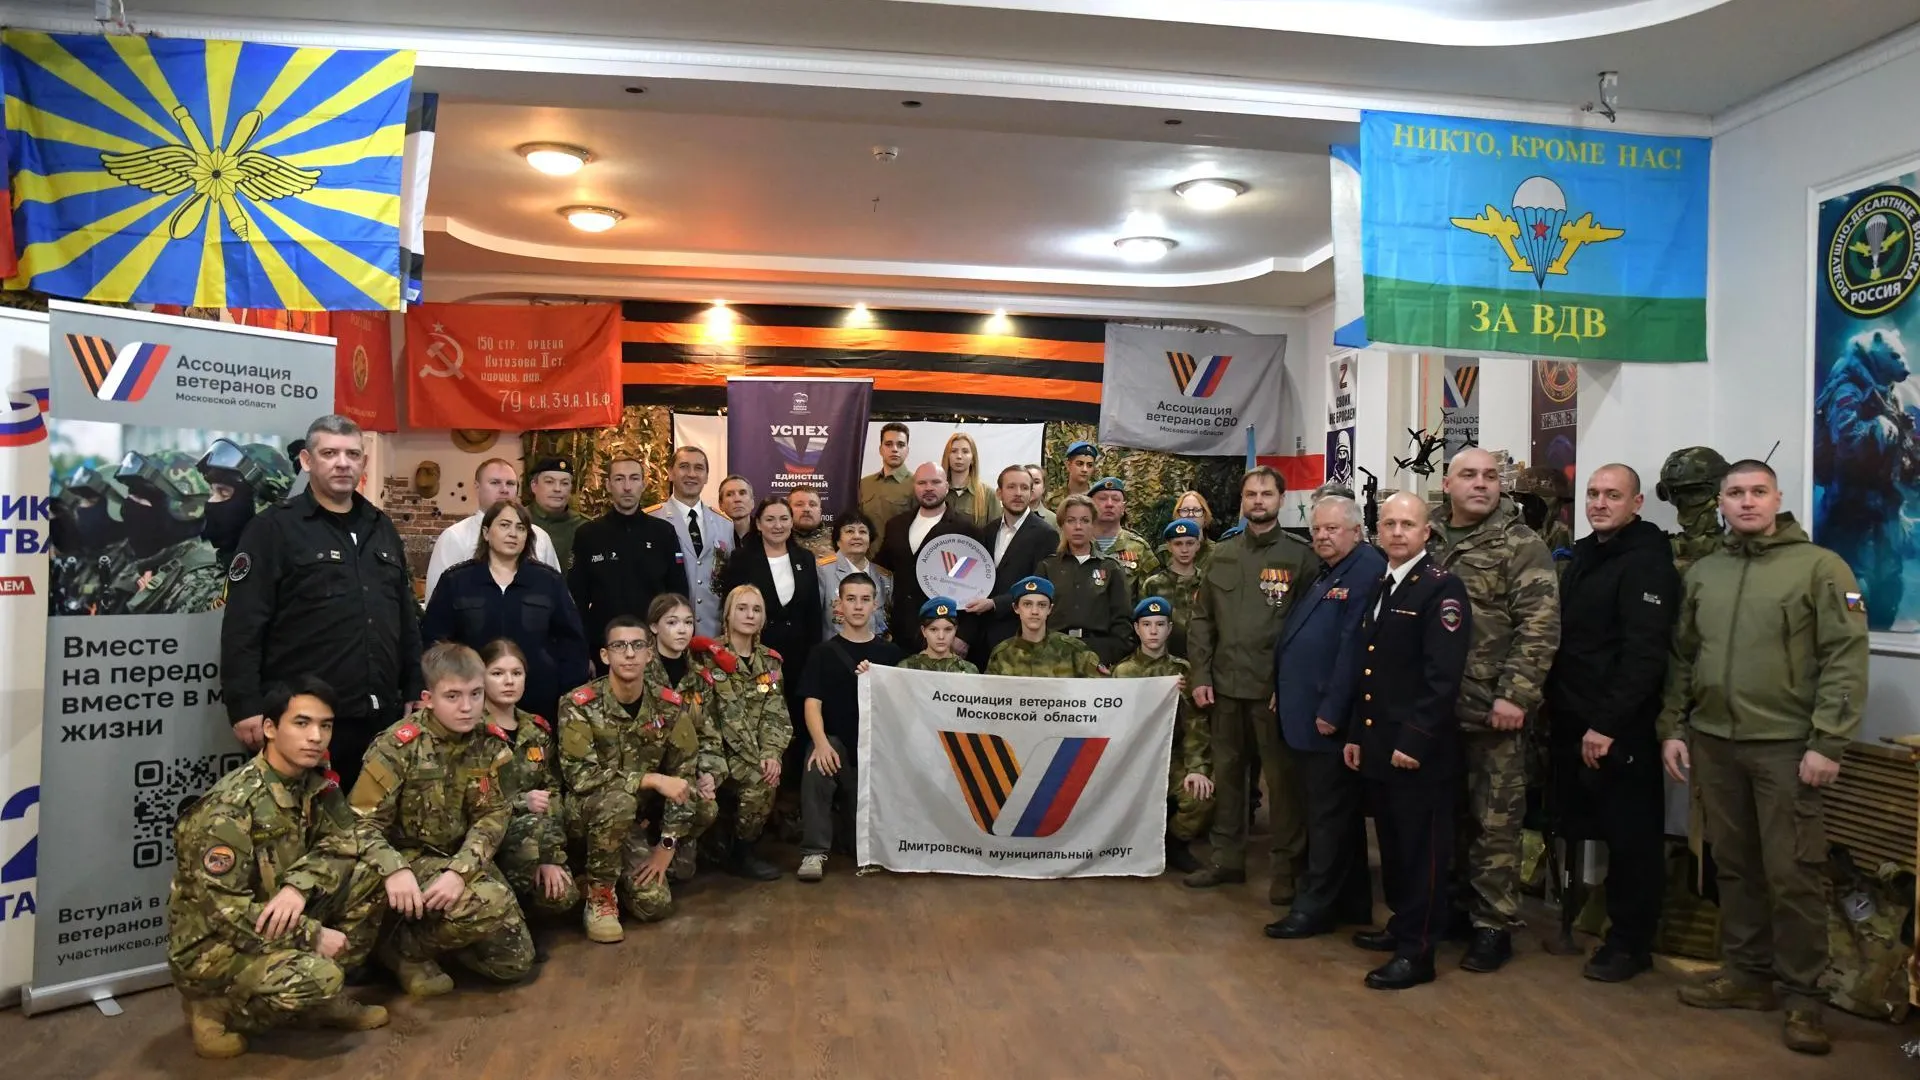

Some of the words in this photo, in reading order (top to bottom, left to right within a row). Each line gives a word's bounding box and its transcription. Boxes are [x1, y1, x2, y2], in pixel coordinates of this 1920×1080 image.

[1393, 123, 1501, 158] НИКТО,
[1510, 136, 1605, 165] КРОМЕ
[1619, 146, 1682, 170] НАС!
[1851, 282, 1901, 305] РОССИЯ
[1471, 301, 1518, 333] ЗА
[1532, 304, 1606, 343] ВДВ
[176, 355, 291, 380] Ассоциация
[176, 375, 275, 396] ветеранов
[280, 383, 318, 400] СВО
[175, 393, 237, 405] Московской
[238, 400, 276, 409] области
[498, 390, 521, 413] 79
[1157, 401, 1232, 416] Ассоциация
[770, 425, 829, 436] УСПЕХ
[1146, 413, 1211, 426] ветеранов
[1214, 417, 1238, 427] СВО
[1159, 426, 1198, 435] Московской
[63, 636, 179, 658] Вместе
[62, 668, 100, 686] на
[62, 691, 174, 714] вместе
[183, 690, 198, 706] в
[932, 690, 1012, 706] Ассоциация
[1019, 698, 1086, 709] ветеранов
[1093, 697, 1122, 708] СВО
[956, 707, 1036, 722] Московской
[1043, 712, 1097, 723] области
[60, 719, 163, 743] жизни
[898, 840, 982, 856] Дмитровский
[989, 848, 1093, 860] муниципальный
[1099, 845, 1133, 858] округ
[58, 896, 142, 924] Вступай
[149, 897, 160, 909] в
[58, 916, 163, 944] ветеранов
